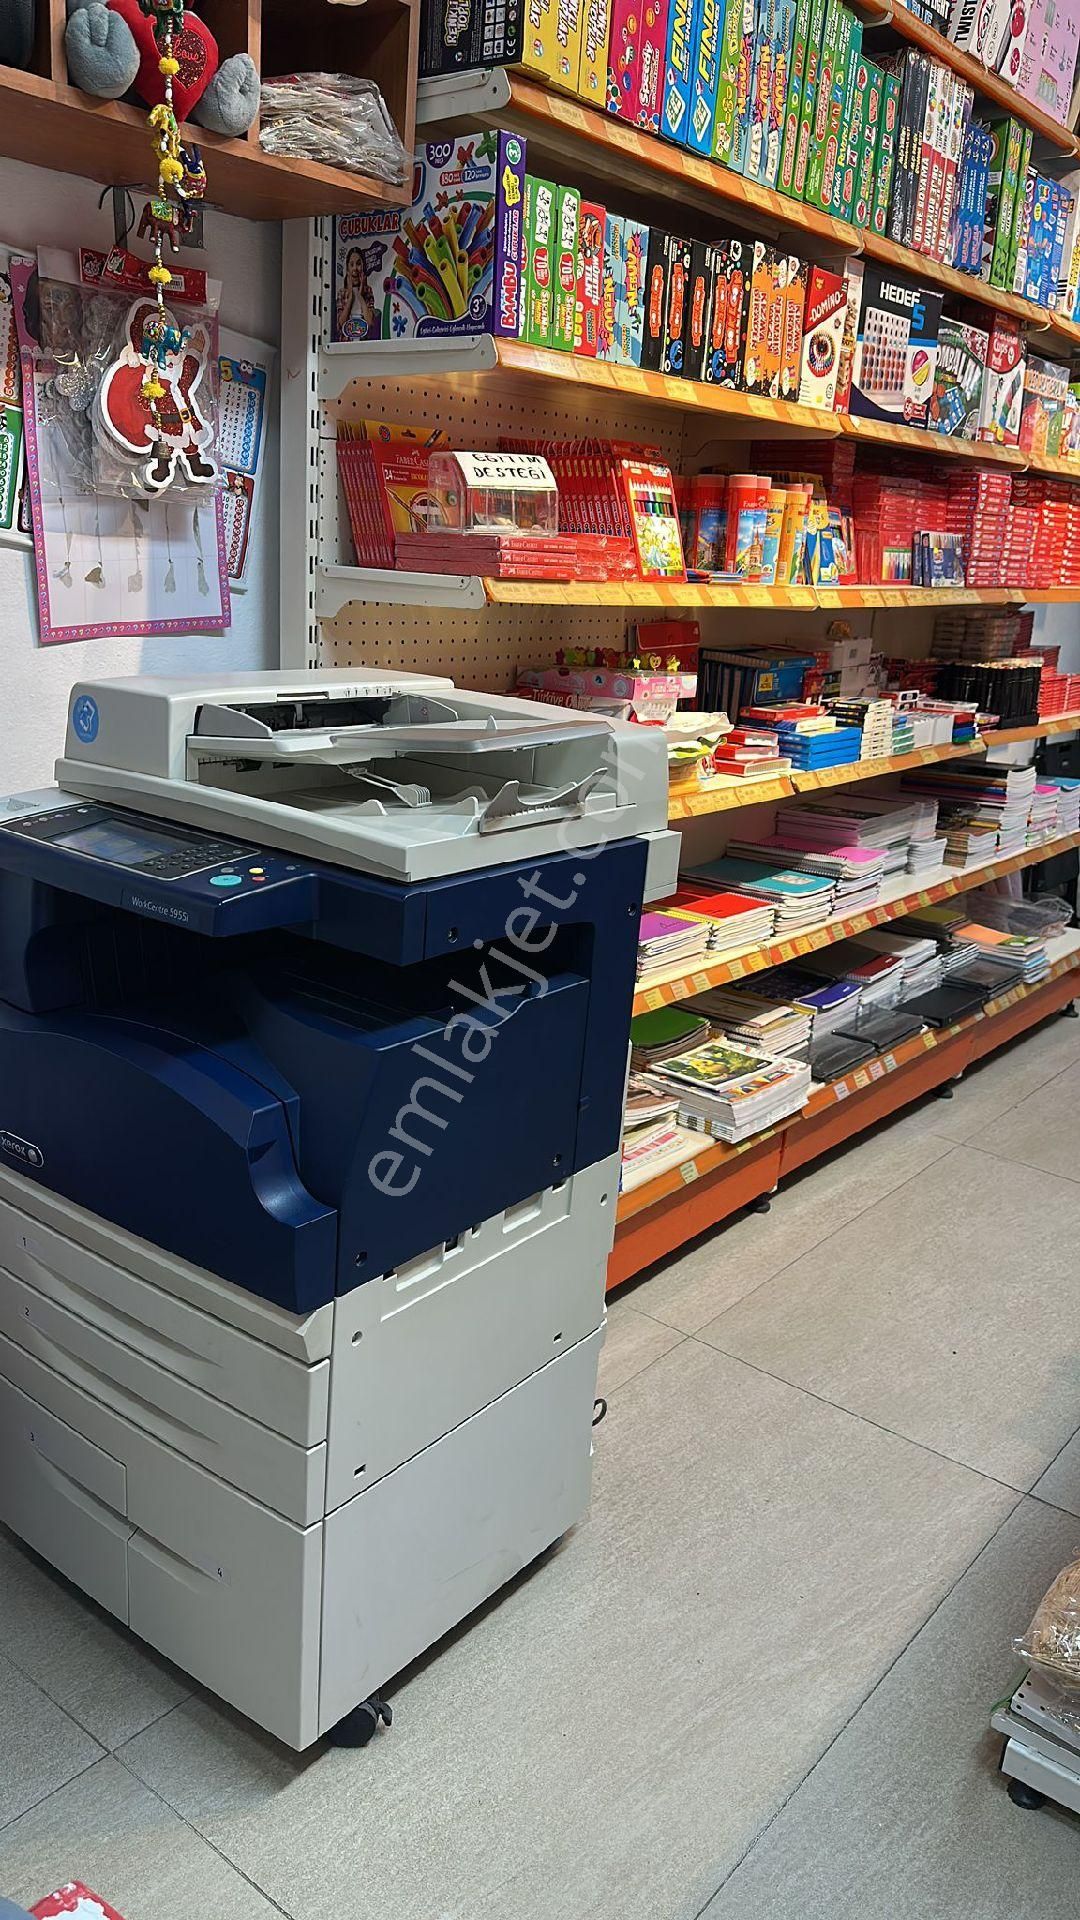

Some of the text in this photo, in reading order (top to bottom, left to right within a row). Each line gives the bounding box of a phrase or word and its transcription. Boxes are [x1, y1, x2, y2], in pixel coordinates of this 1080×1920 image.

[430, 143, 451, 160] 300
[501, 261, 517, 330] BAMBU
[880, 281, 921, 308] HEDEF
[912, 304, 926, 330] 5
[131, 895, 169, 917] WorkCentre
